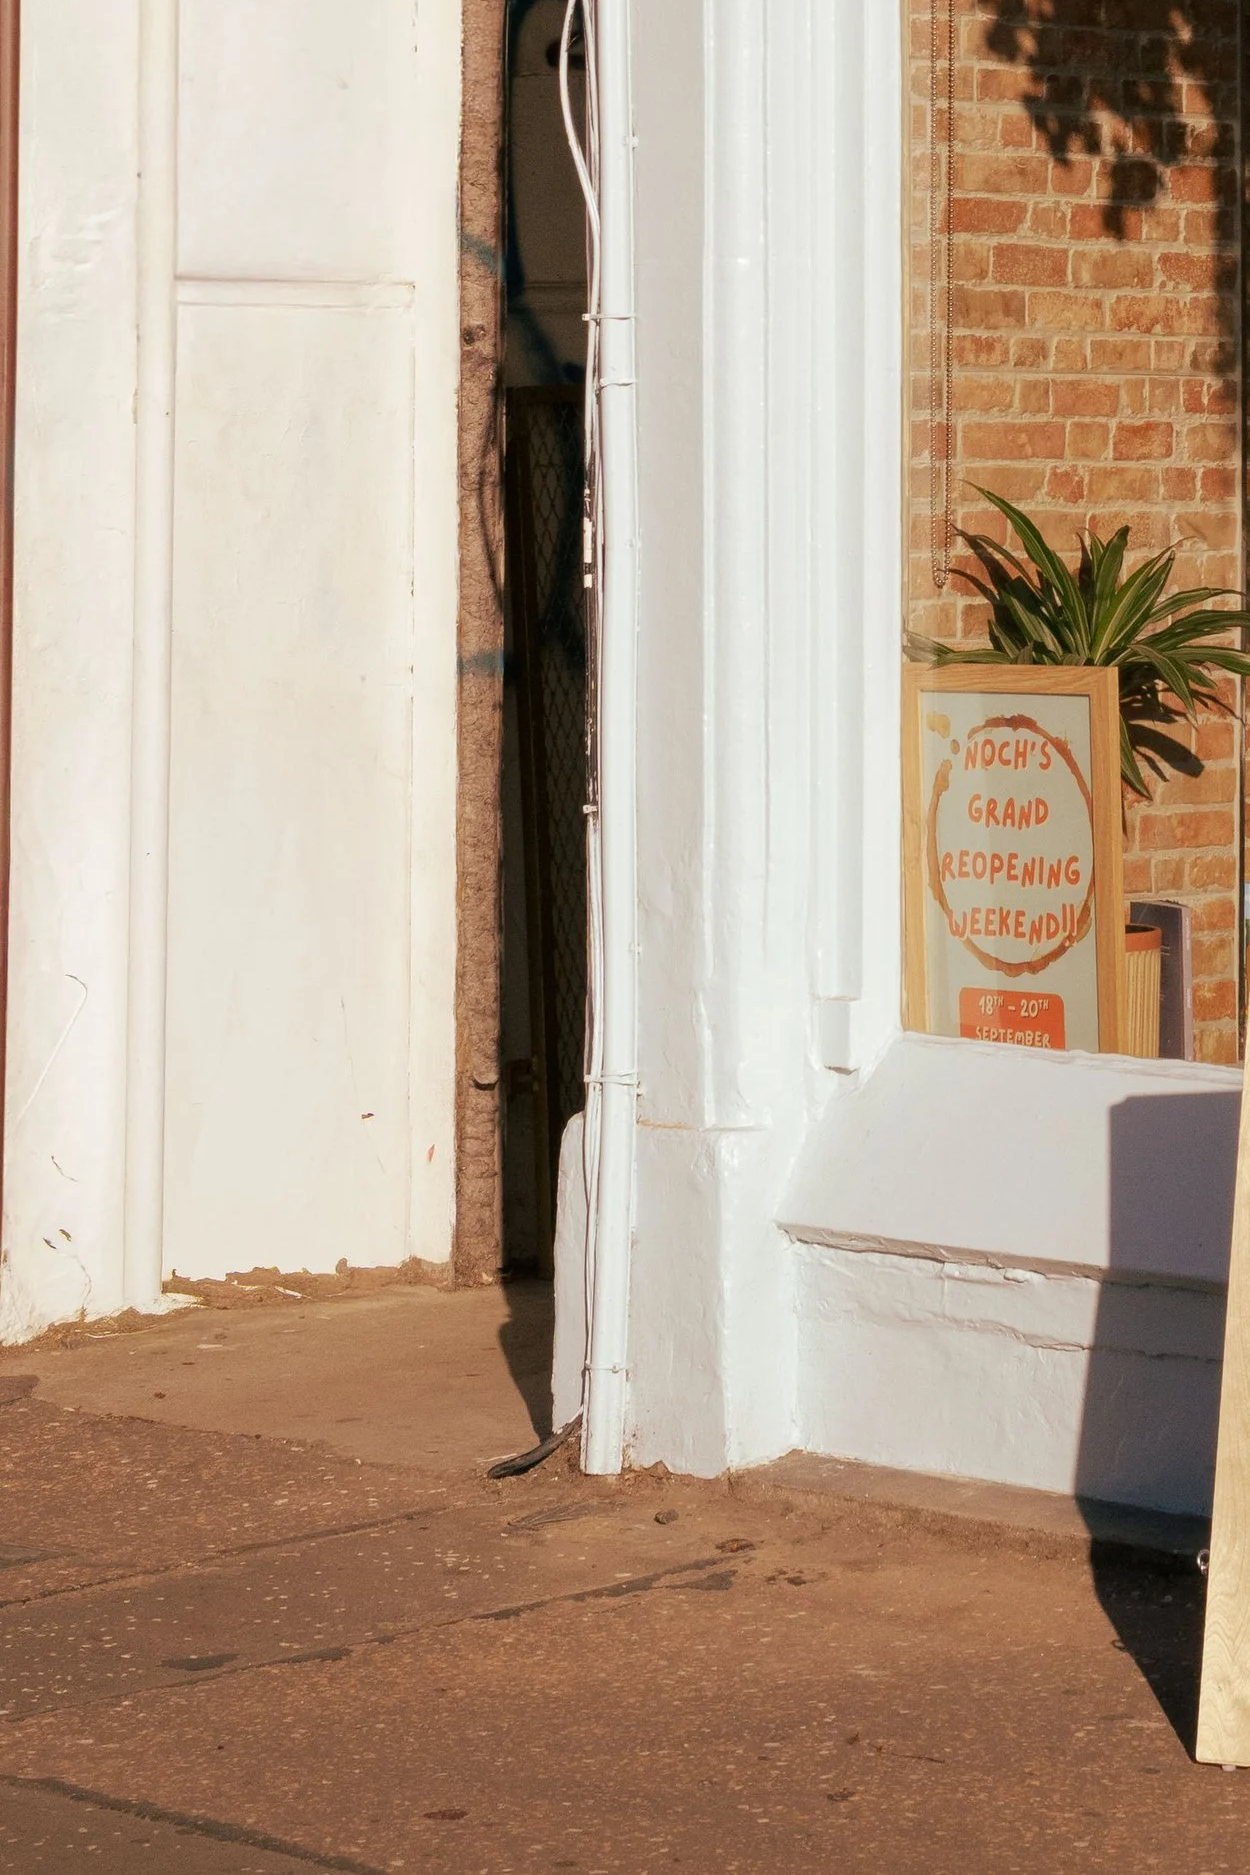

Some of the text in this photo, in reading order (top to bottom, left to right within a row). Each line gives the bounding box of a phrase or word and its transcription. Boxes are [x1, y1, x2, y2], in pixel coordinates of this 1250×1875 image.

[964, 738, 1051, 770] NOCH'S
[968, 793, 1049, 830] GRAND
[941, 849, 1081, 889] REOPENING
[949, 903, 1077, 947] WEEKEND!!
[979, 995, 1004, 1015] 18TH
[1021, 999, 1049, 1018] 20TH
[975, 1026, 1051, 1048] SEPTEMBER
